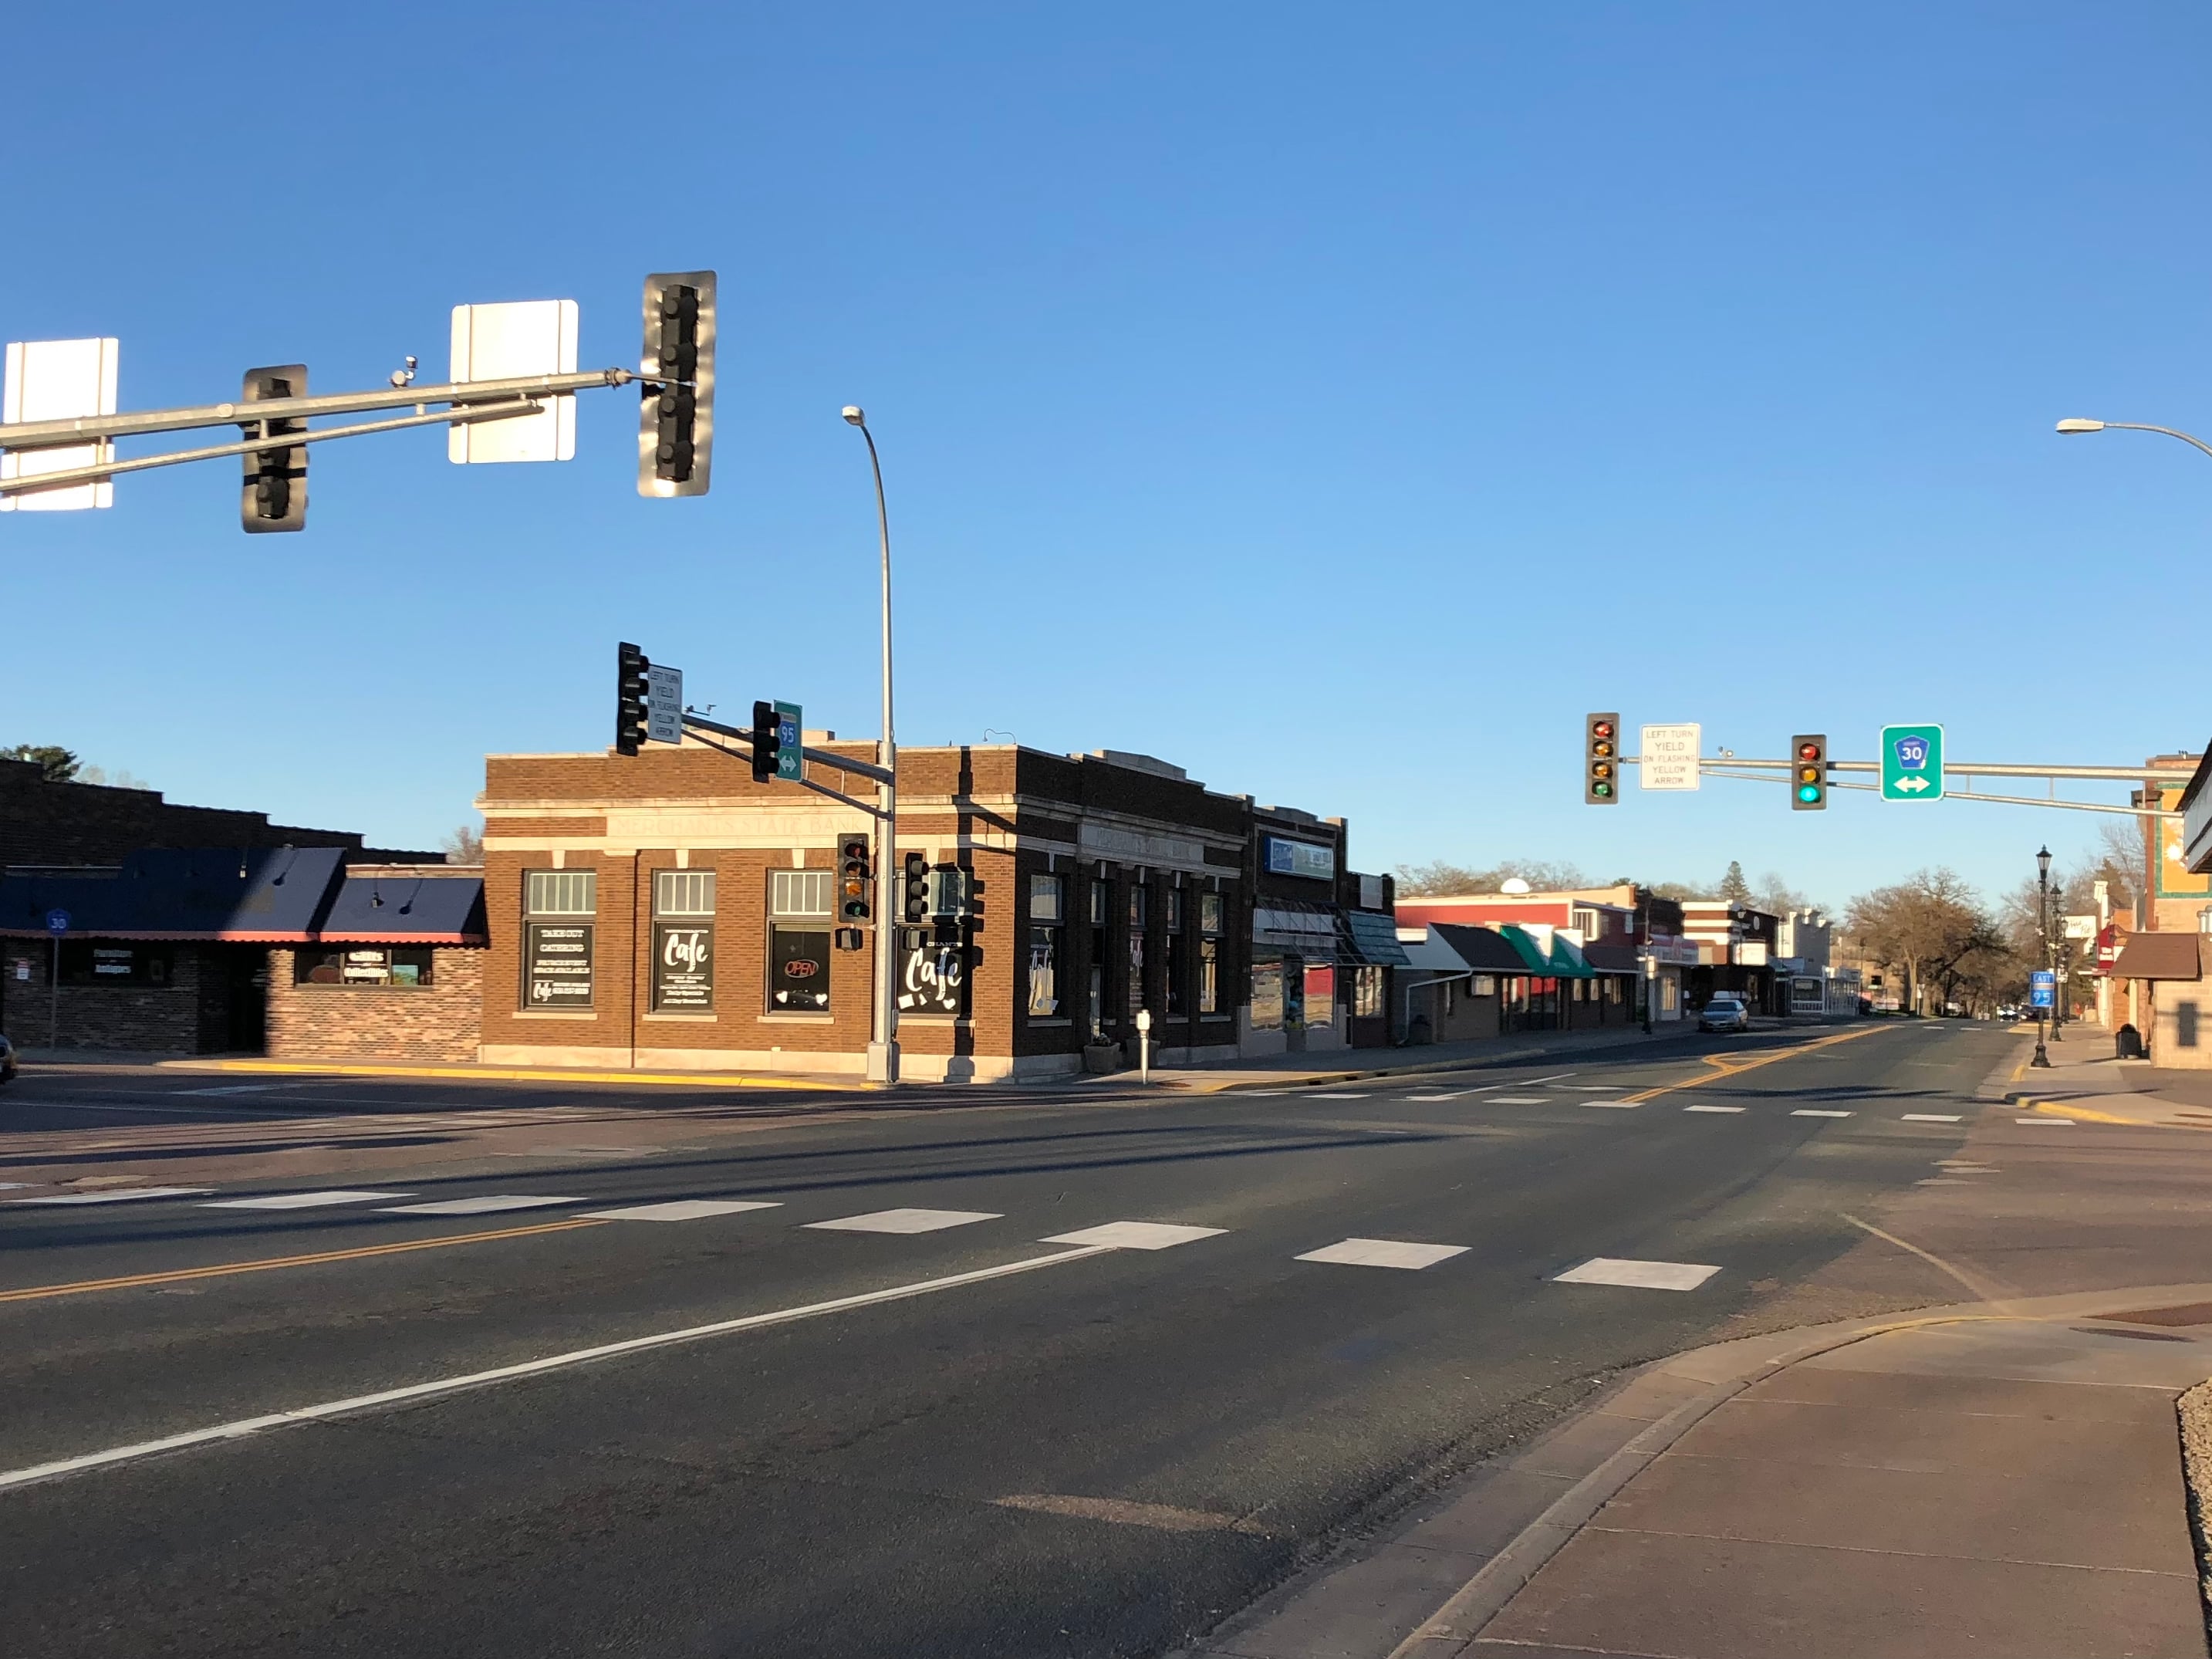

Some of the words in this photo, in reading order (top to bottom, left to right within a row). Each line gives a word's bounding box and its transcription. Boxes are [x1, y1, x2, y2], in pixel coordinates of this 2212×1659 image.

[781, 725, 795, 743] 95
[1655, 742, 1685, 751] YIELD
[1901, 747, 1922, 760] 30
[51, 918, 67, 929] 30
[664, 934, 709, 972] Cafe
[787, 961, 816, 976] OPEN
[906, 948, 962, 1001] Cafe
[2033, 992, 2051, 1002] 95
